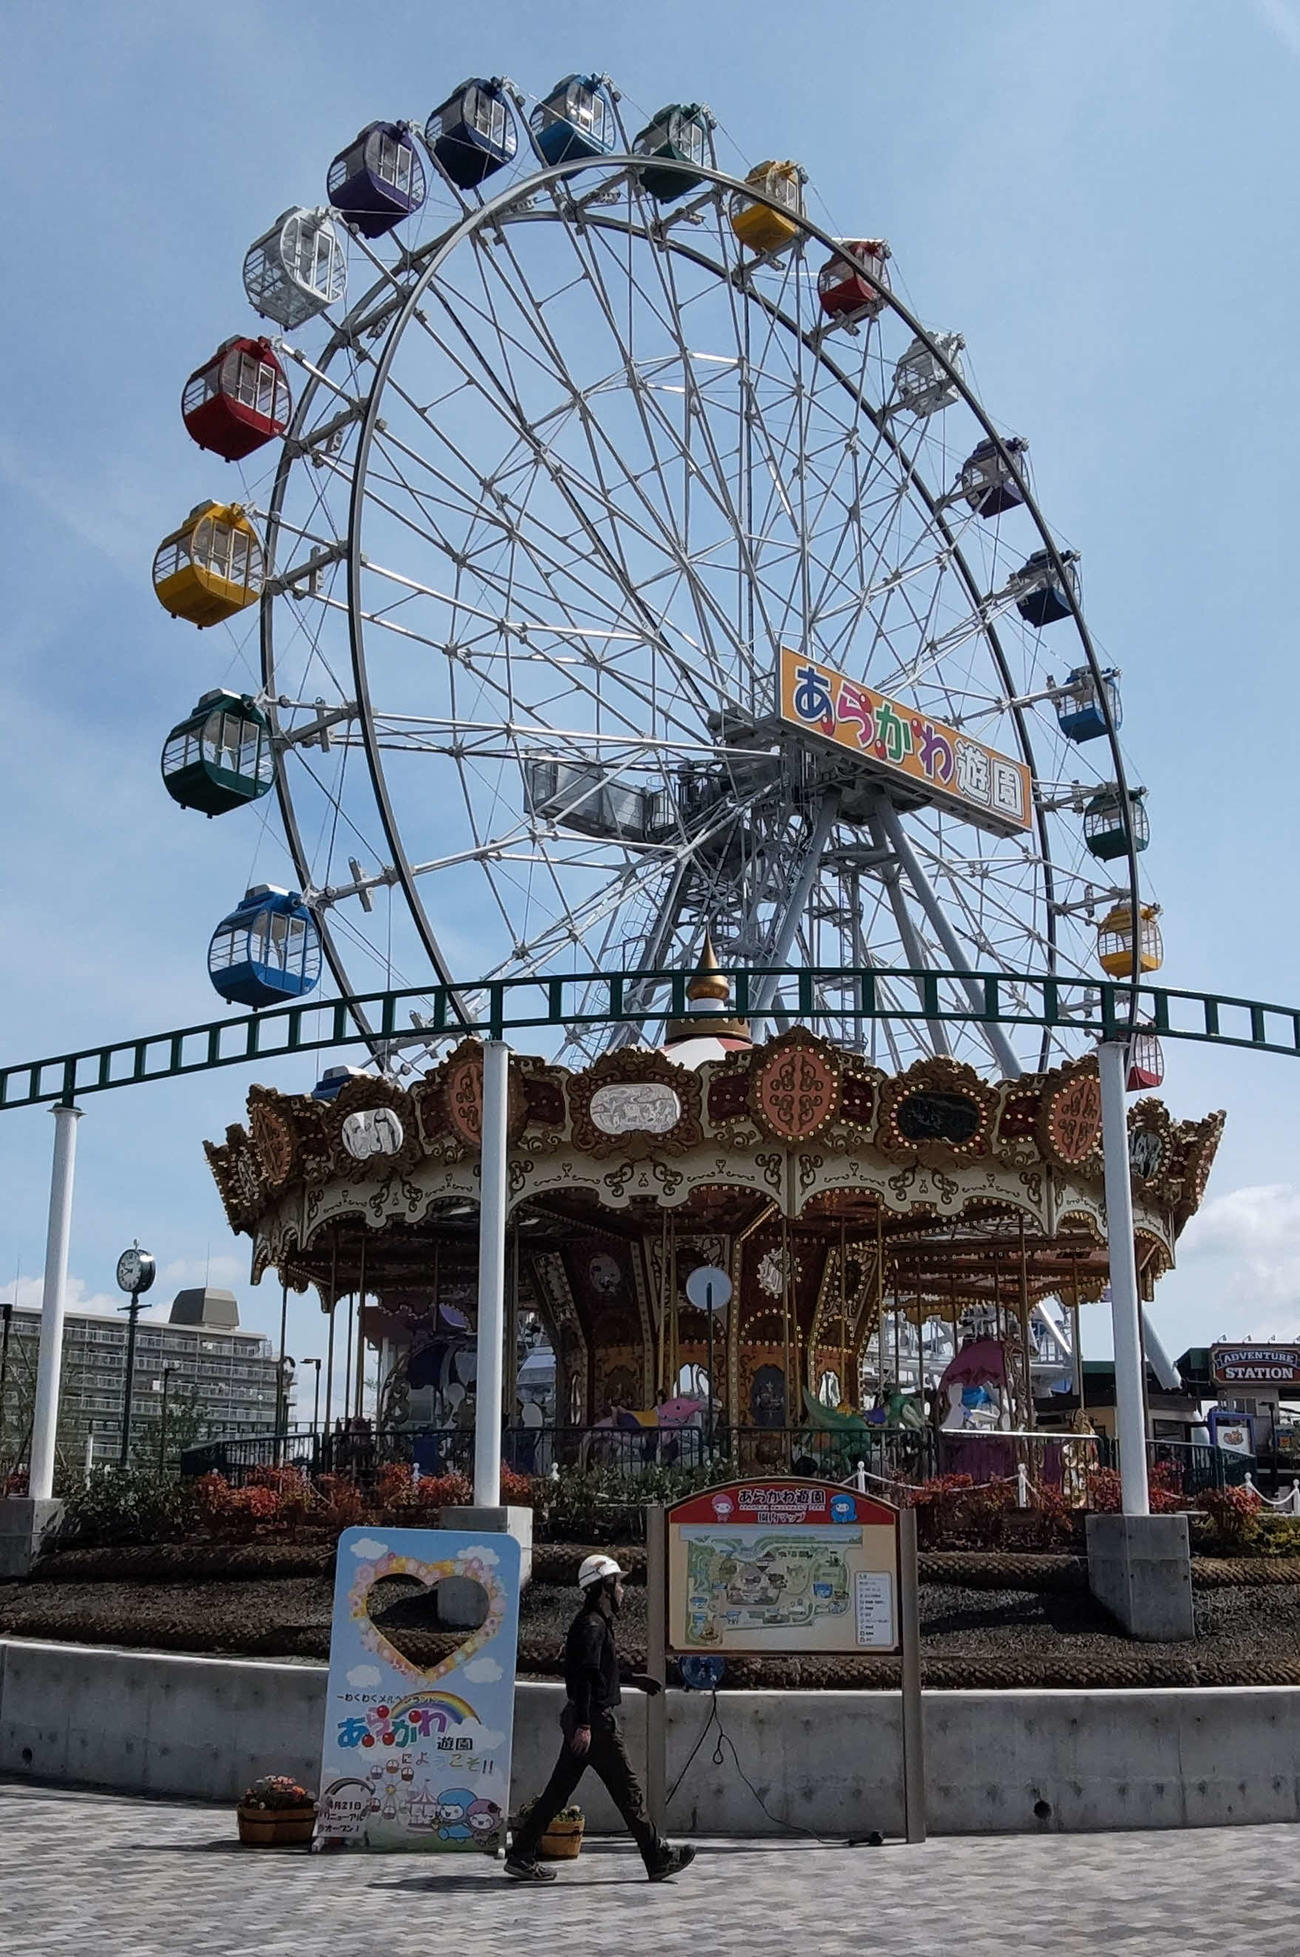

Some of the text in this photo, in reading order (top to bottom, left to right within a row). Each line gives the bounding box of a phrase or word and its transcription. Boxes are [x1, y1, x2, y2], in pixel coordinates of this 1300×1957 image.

[794, 664, 1025, 821] あらかわ遊園
[1224, 1351, 1294, 1364] ADVENTURE
[1225, 1367, 1294, 1379] STATION
[738, 1489, 826, 1504] あらかわ遊園
